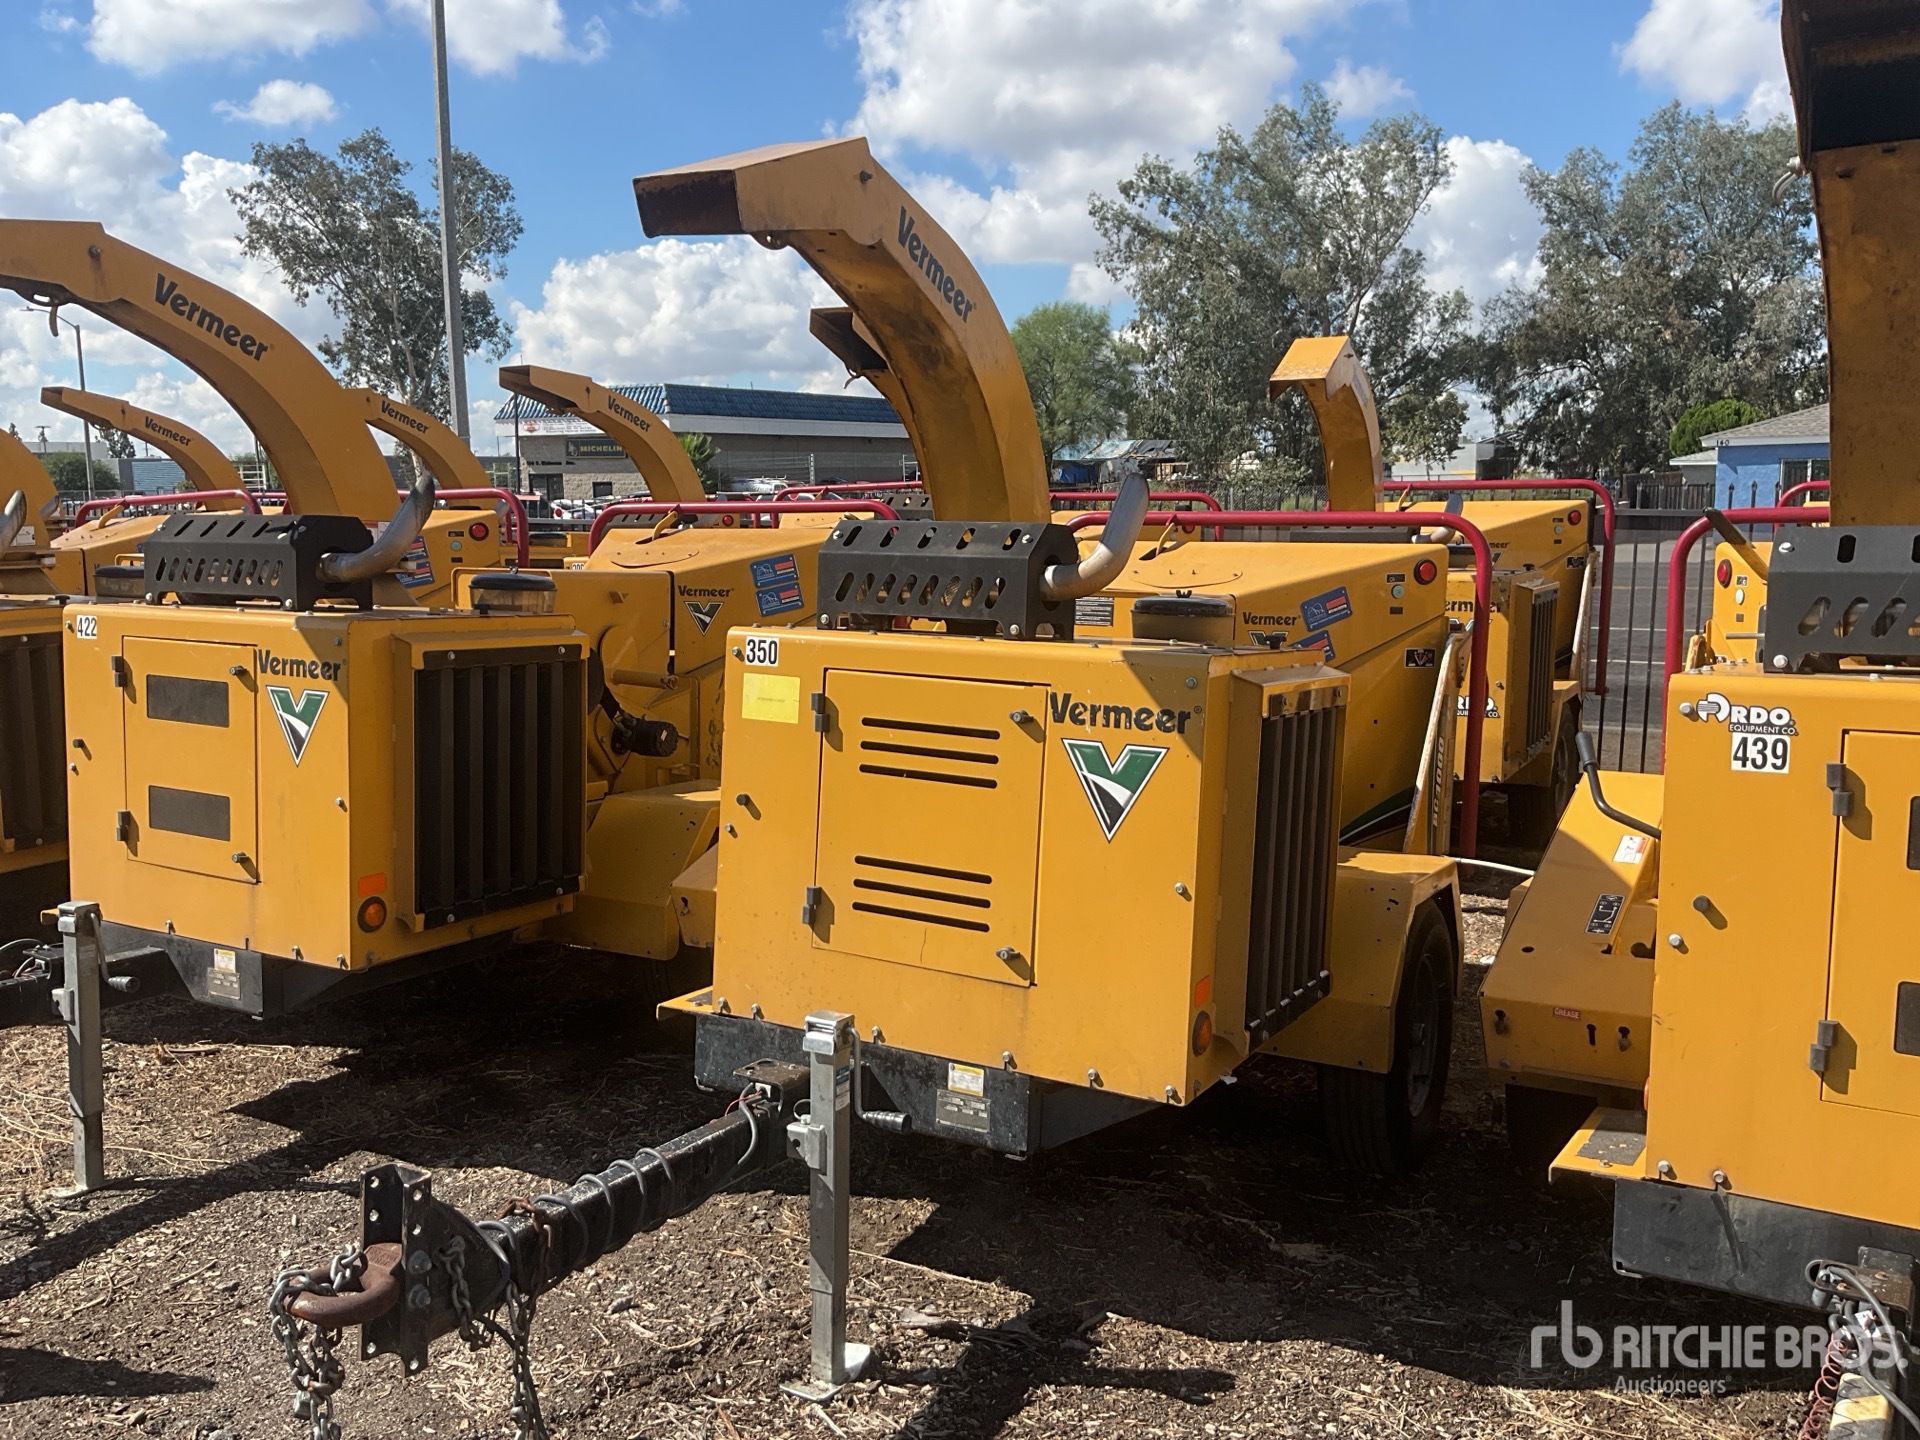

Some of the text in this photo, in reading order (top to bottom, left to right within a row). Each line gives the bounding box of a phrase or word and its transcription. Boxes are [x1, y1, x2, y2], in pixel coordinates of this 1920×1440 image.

[898, 205, 973, 323] Vermeer
[155, 273, 268, 361] Vermeer
[381, 400, 429, 434] Vermeer
[608, 395, 651, 432] Vermeer
[145, 416, 191, 446] Vermeer
[678, 585, 731, 598] Vermeer
[77, 617, 97, 637] 422
[1243, 611, 1298, 627] Vermeer
[258, 649, 341, 681] Vermeer
[746, 638, 778, 665] 350
[1050, 691, 1191, 734] Vermeer
[1729, 723, 1799, 736] EQUIPMENT CO.
[1732, 736, 1789, 772] 439
[1554, 1007, 1580, 1019] GREASE
